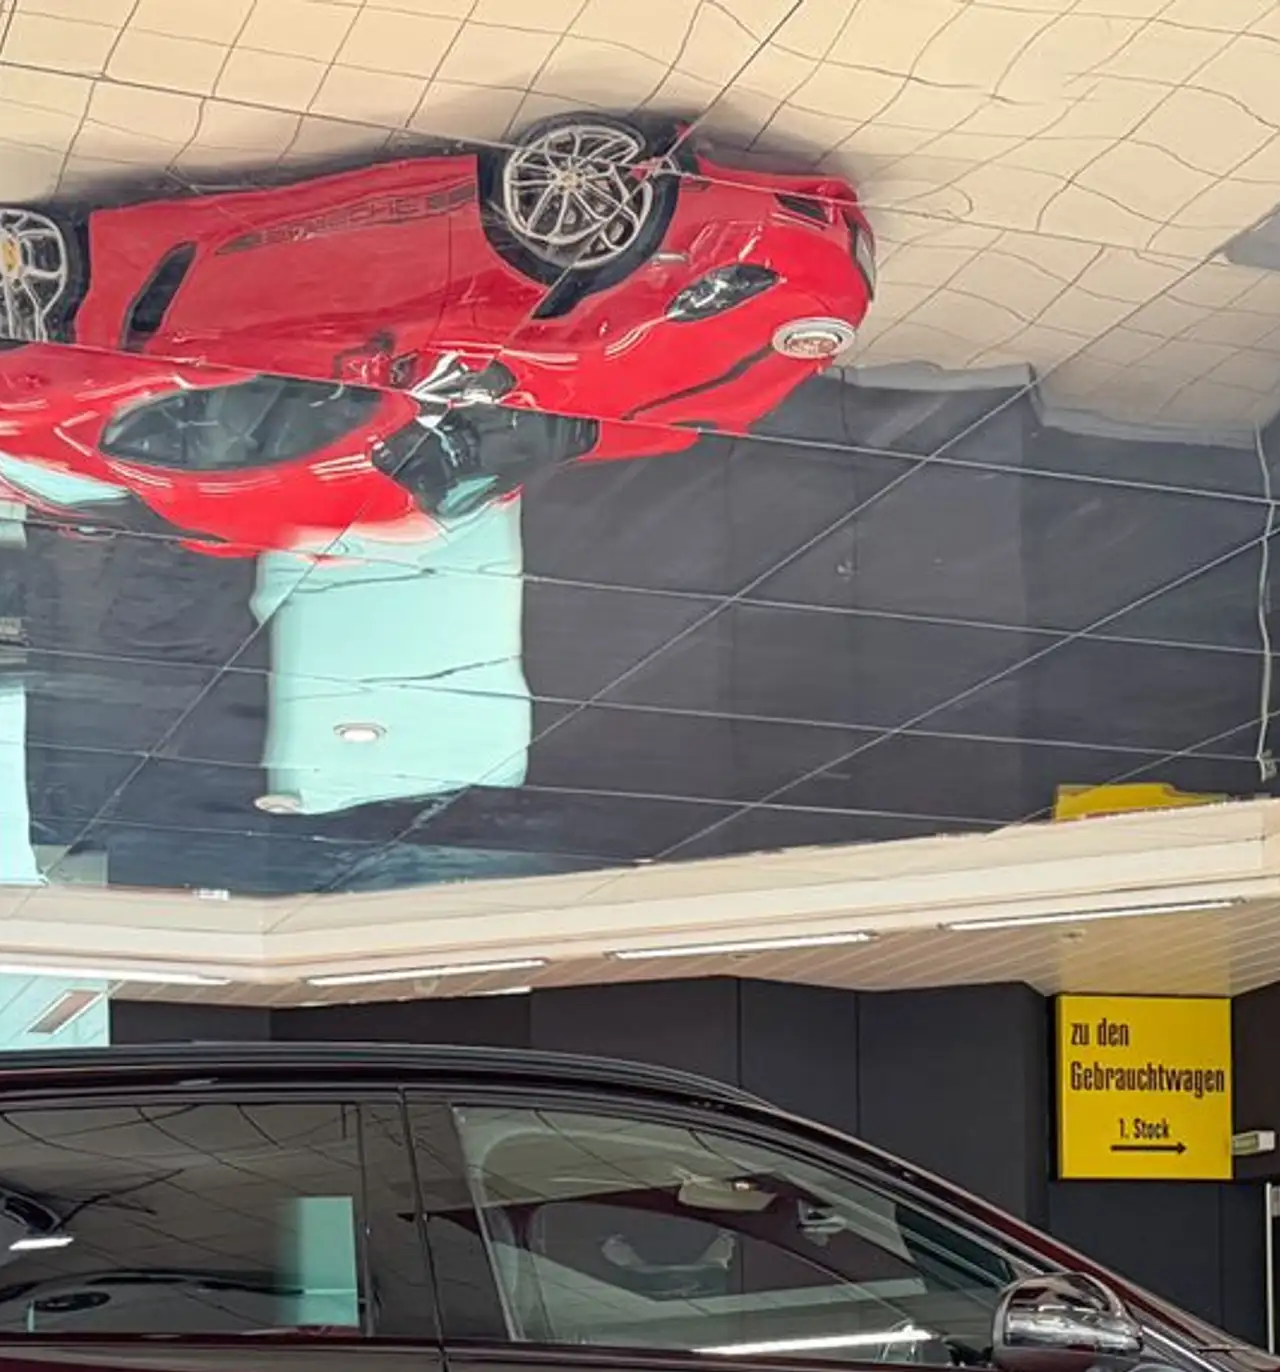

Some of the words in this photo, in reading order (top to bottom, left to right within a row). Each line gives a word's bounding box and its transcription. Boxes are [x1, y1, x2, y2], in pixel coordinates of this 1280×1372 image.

[1071, 1021, 1090, 1046] zu
[1096, 1017, 1130, 1047] den
[1070, 1060, 1225, 1099] Gebrauchtwagen
[1119, 1117, 1129, 1138] 1.
[1133, 1117, 1170, 1139] Stock
